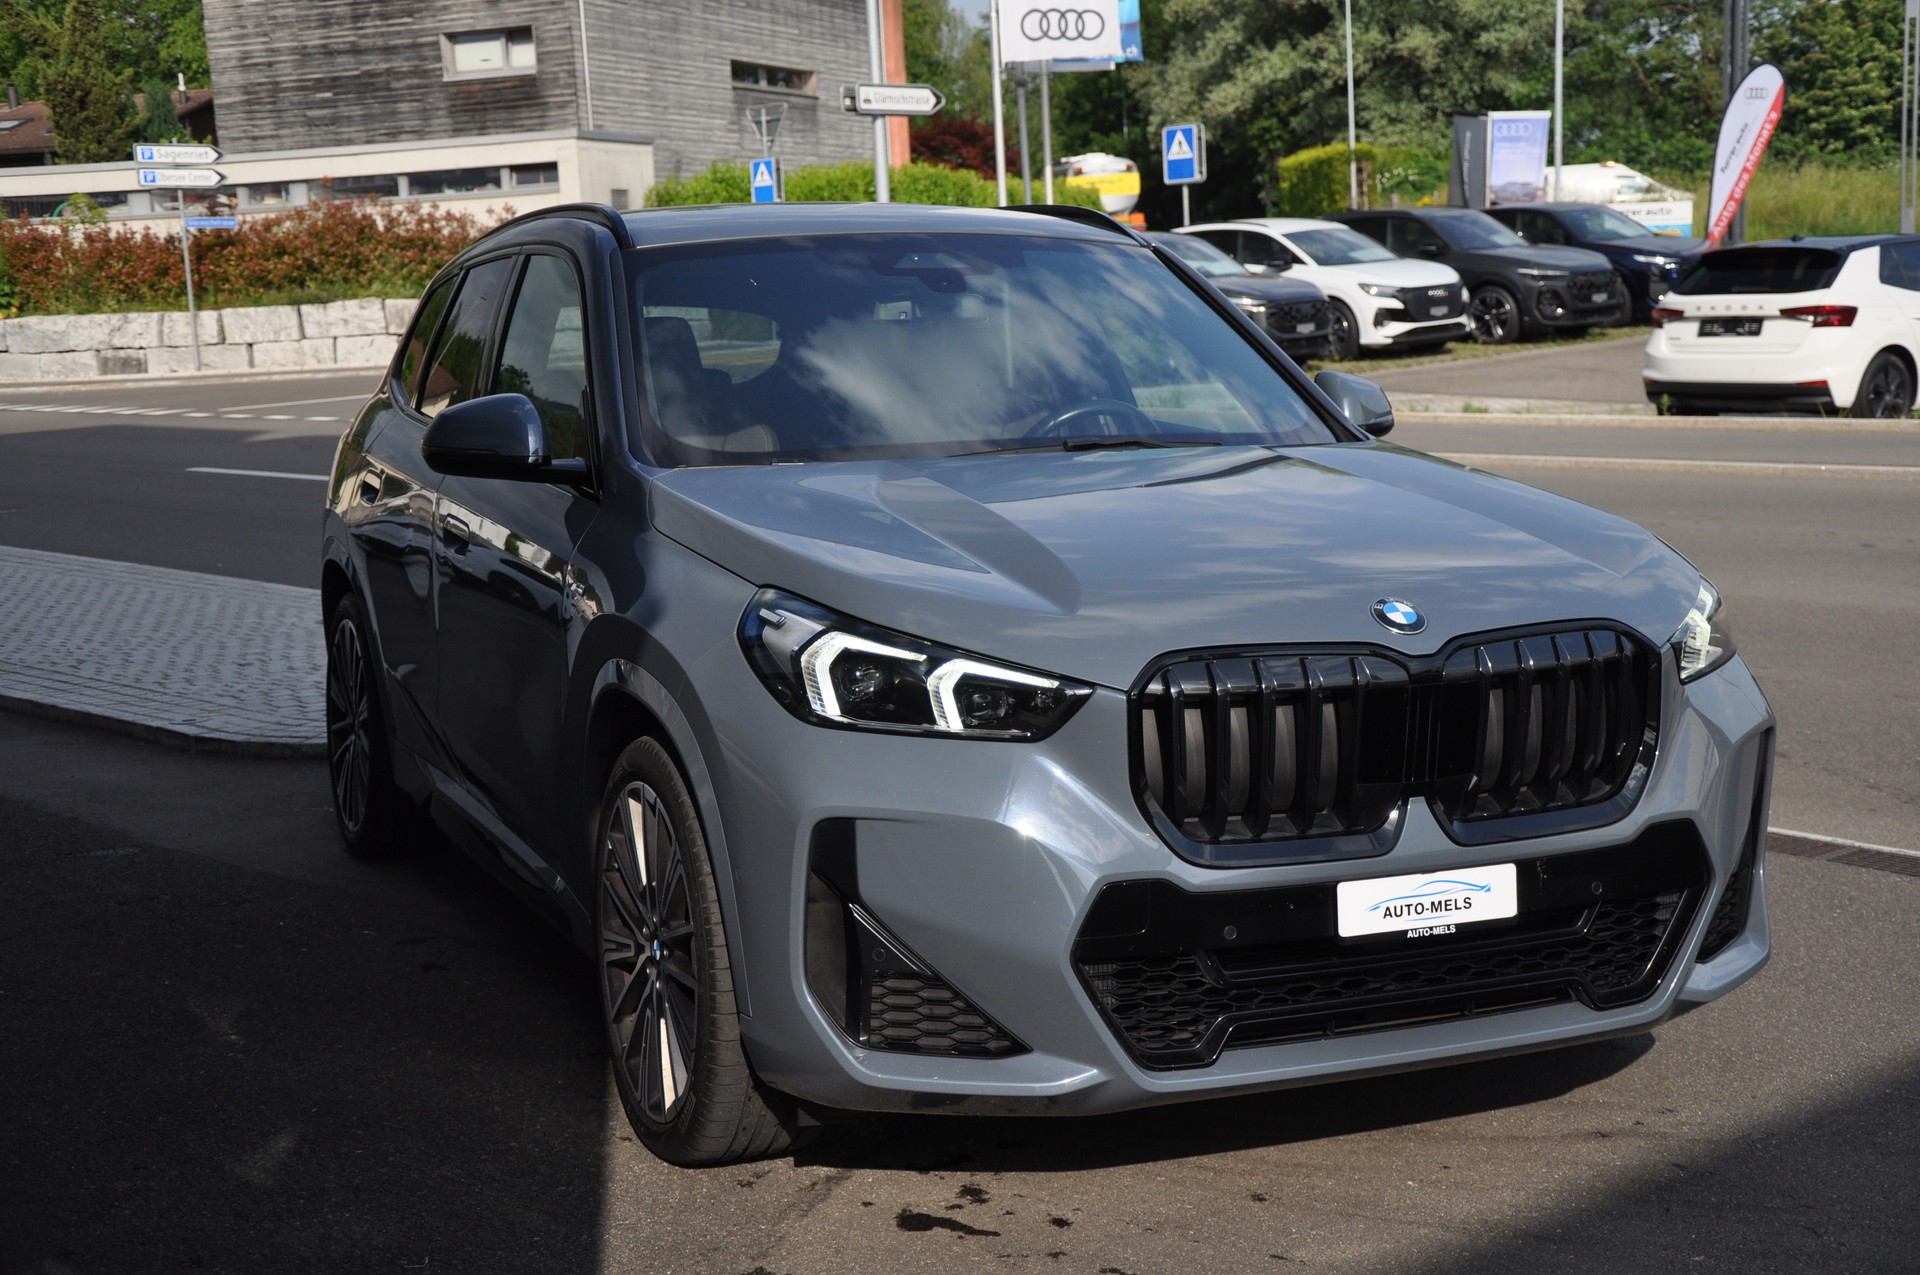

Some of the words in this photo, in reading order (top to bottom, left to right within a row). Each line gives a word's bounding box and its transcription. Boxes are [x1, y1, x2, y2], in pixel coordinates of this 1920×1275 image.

[156, 148, 209, 162] Sagenriet
[187, 172, 213, 183] Center
[1712, 200, 1737, 238] Auto
[1733, 173, 1751, 199] des
[1382, 896, 1473, 919] AUTO-MELS
[1406, 924, 1456, 939] AUTO-MELS
